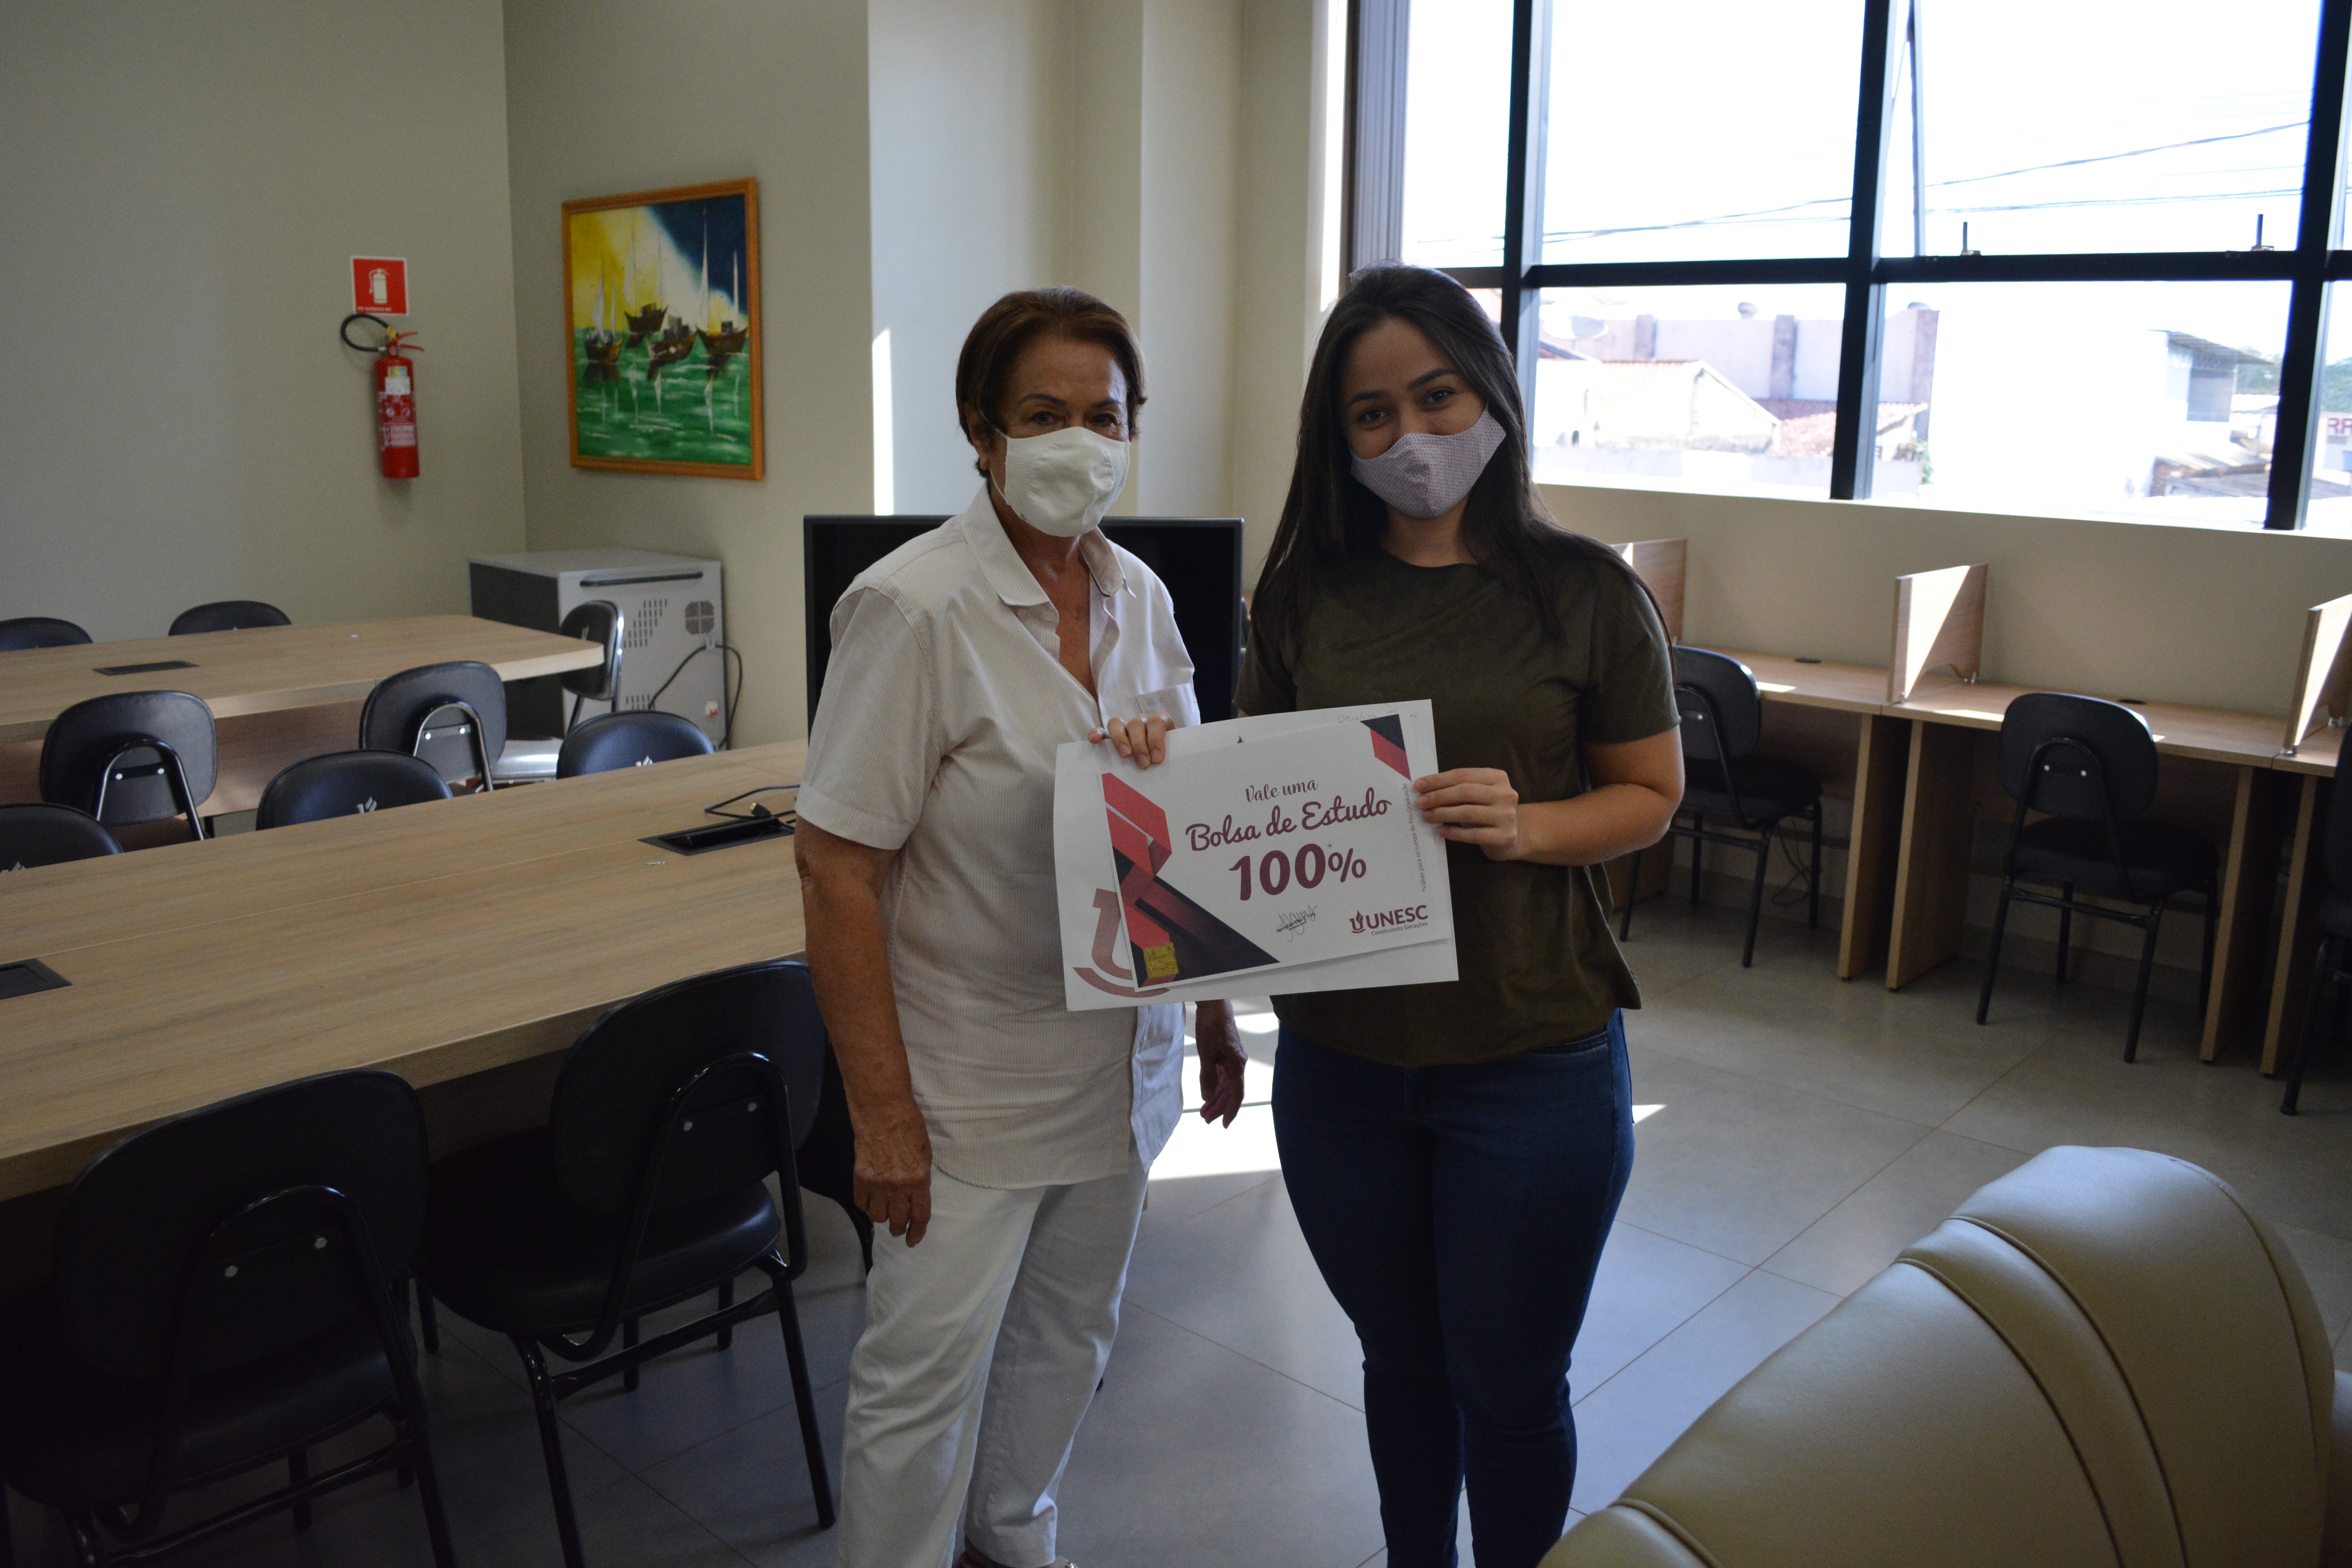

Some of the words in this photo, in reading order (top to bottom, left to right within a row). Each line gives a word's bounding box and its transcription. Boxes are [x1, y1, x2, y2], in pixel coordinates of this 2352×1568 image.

[1245, 784, 1279, 802] Vale
[1282, 780, 1318, 796] uma
[1403, 783, 1413, 824] Pós-Graduação
[1185, 814, 1261, 851] Bolsa
[1266, 805, 1298, 837] de
[1301, 787, 1392, 830] Estudo
[1365, 905, 1428, 929] UNESC
[1371, 926, 1403, 936] Construindo
[1404, 922, 1428, 930] Gerações
